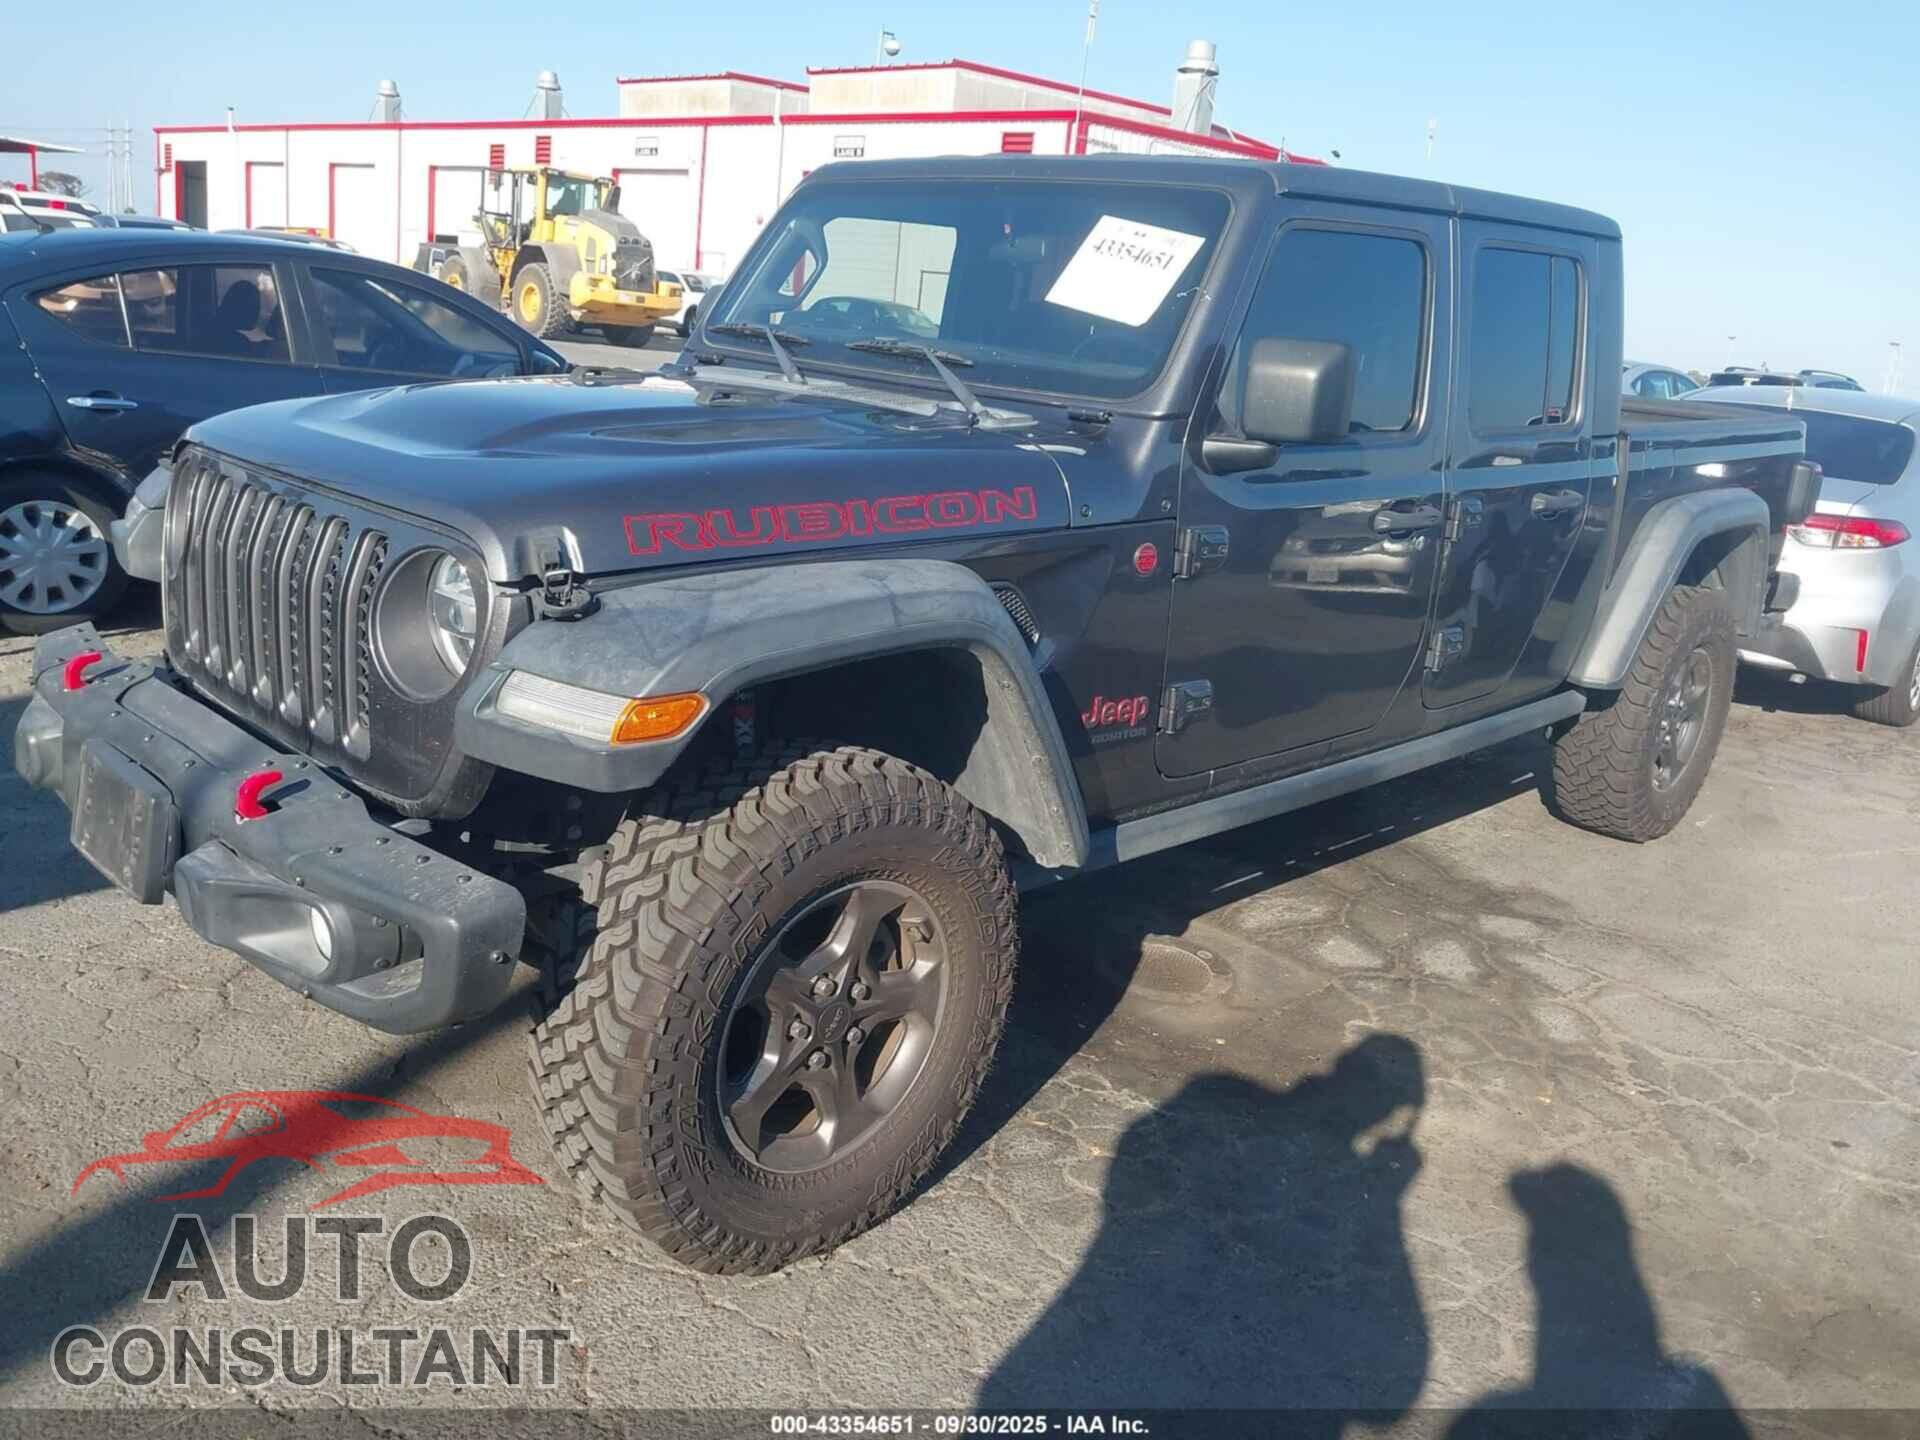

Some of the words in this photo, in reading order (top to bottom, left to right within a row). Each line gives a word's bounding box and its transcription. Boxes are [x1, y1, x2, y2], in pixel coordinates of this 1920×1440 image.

[1093, 237, 1175, 270] 43354651
[623, 486, 1038, 556] RUBICON
[1081, 696, 1149, 729] Jeep
